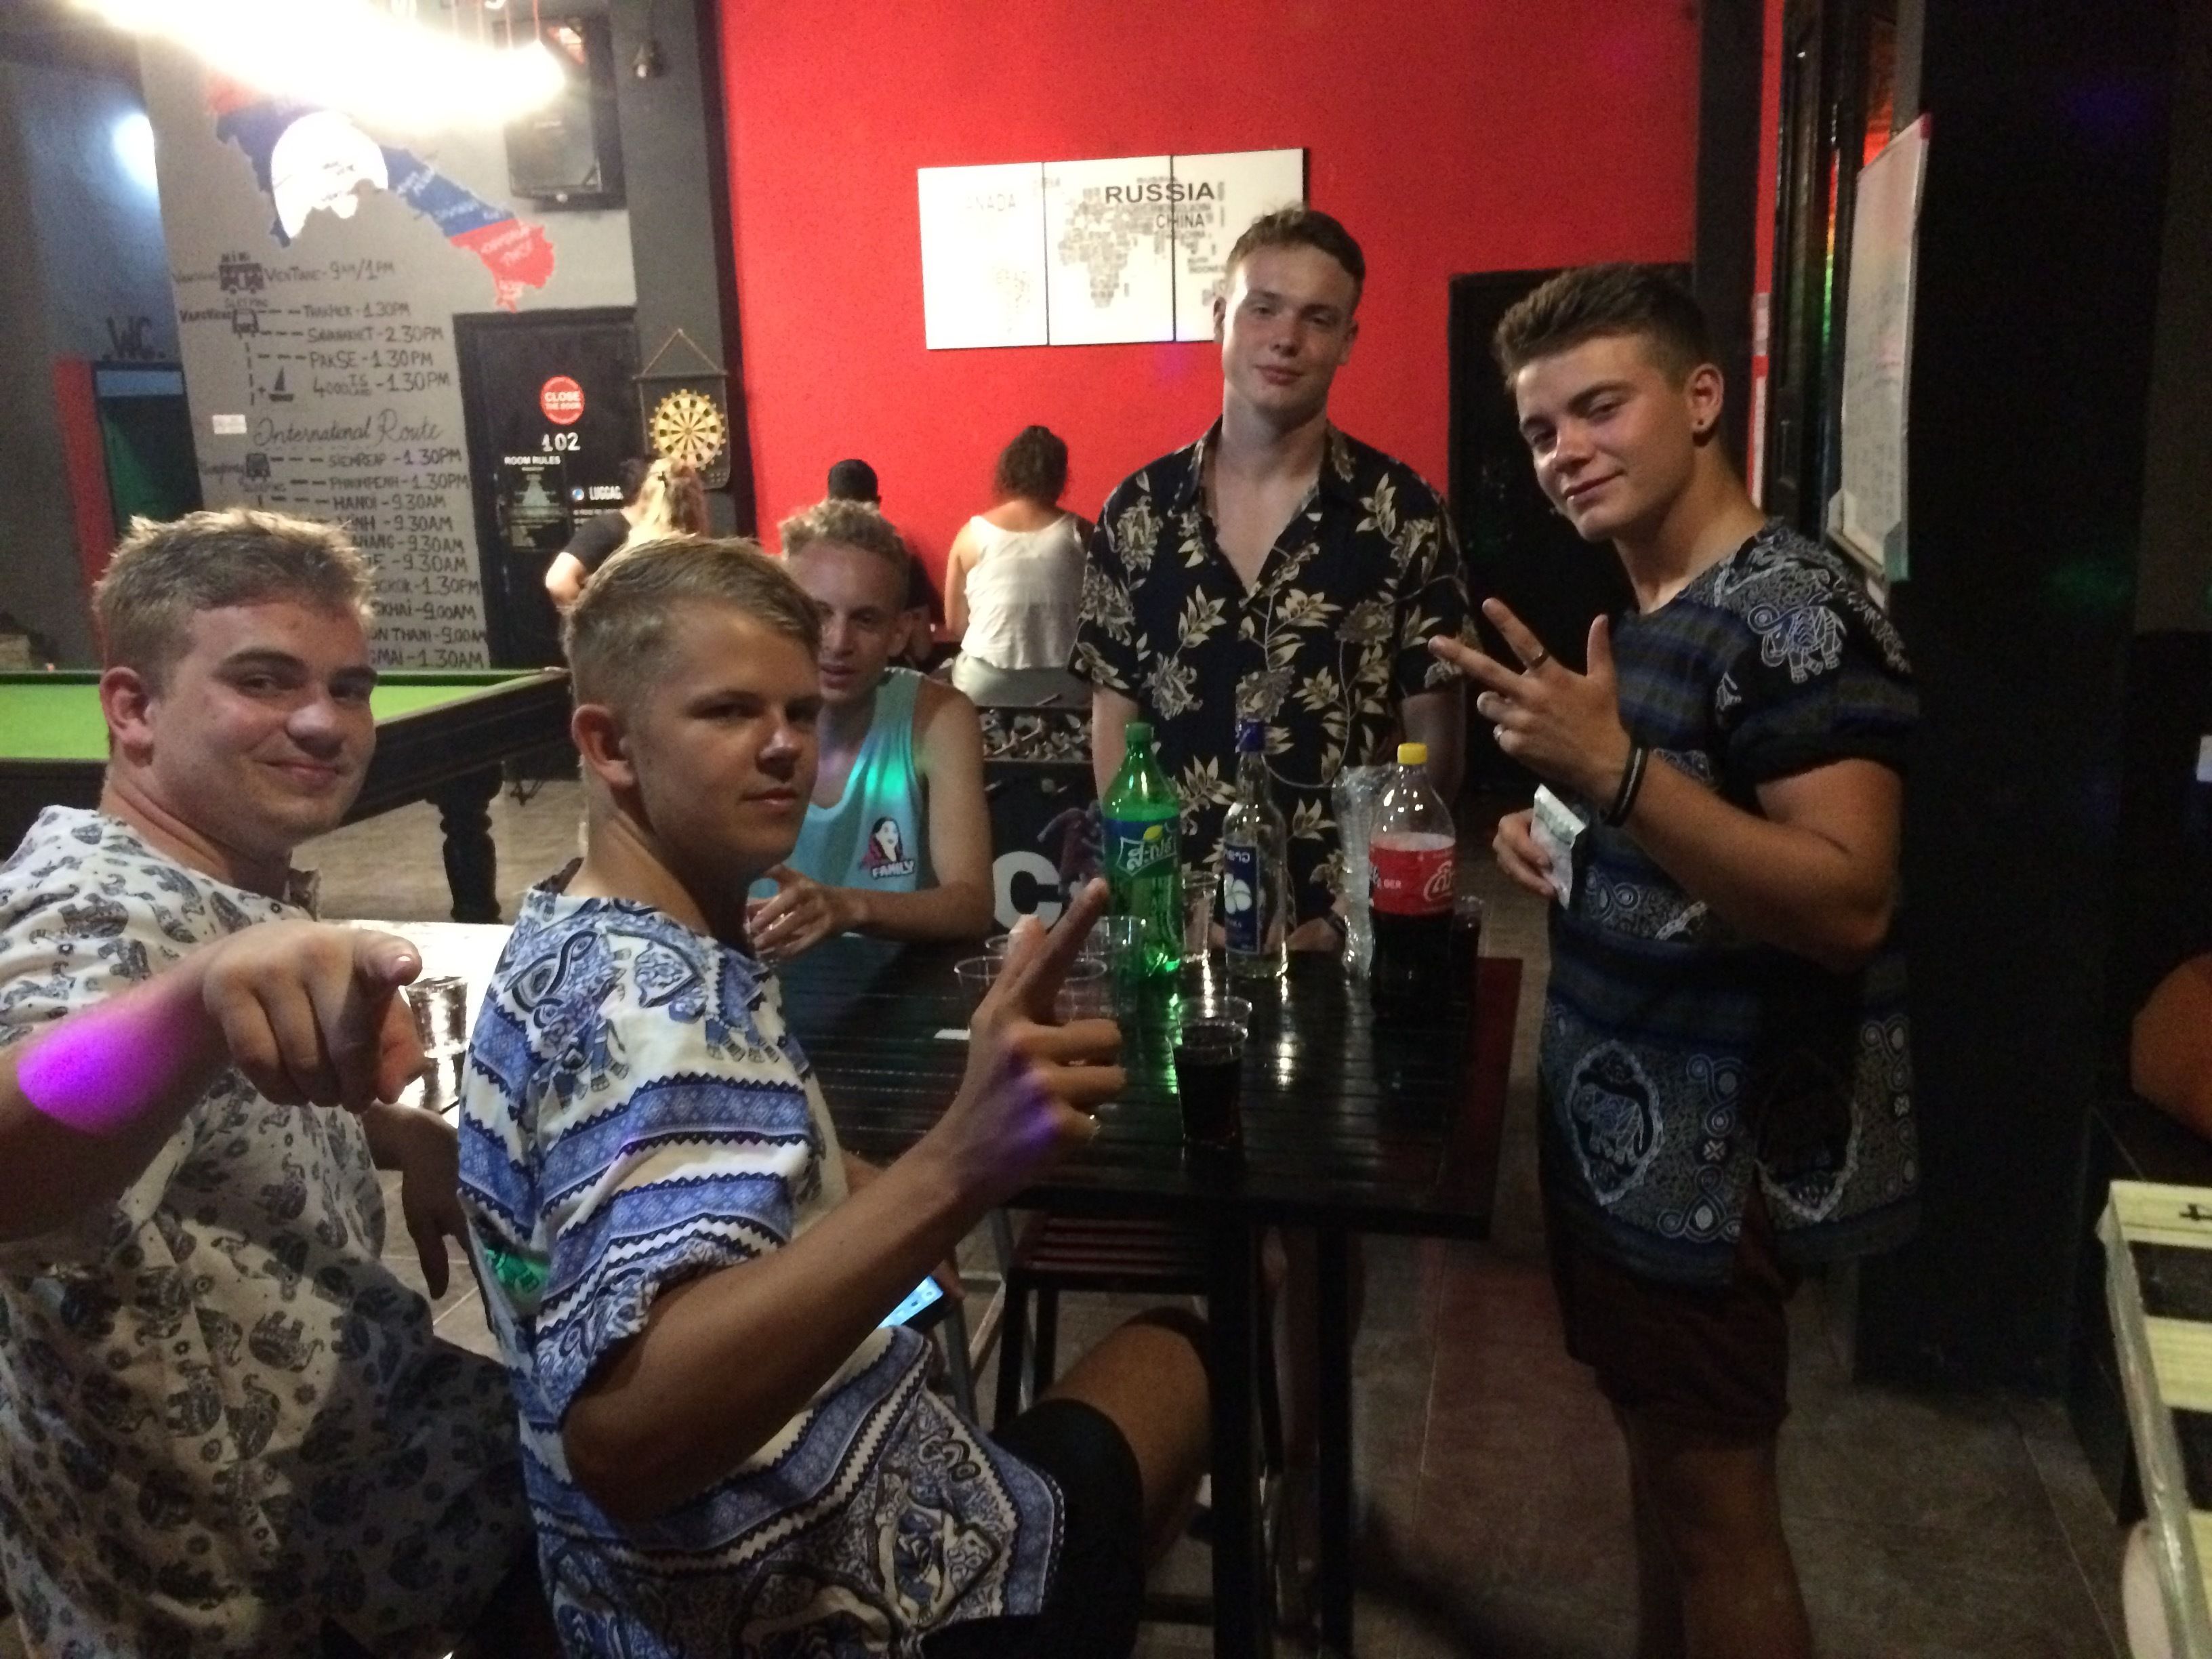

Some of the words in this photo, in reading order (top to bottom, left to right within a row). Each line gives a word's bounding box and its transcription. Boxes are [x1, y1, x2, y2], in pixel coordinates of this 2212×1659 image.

[965, 192, 1016, 211] ANADA
[1105, 182, 1214, 203] RUSSIA
[1156, 213, 1205, 228] CHINA
[310, 350, 357, 369] PAKSE
[544, 391, 581, 402] CLOSE
[375, 408, 444, 449] Route
[541, 432, 581, 452] 102
[504, 455, 531, 465] ROOM
[532, 455, 561, 465] RULES
[332, 495, 377, 510] HANOI
[392, 628, 432, 642] THANI
[872, 860, 915, 879] FAMILY
[993, 851, 1063, 934] C
